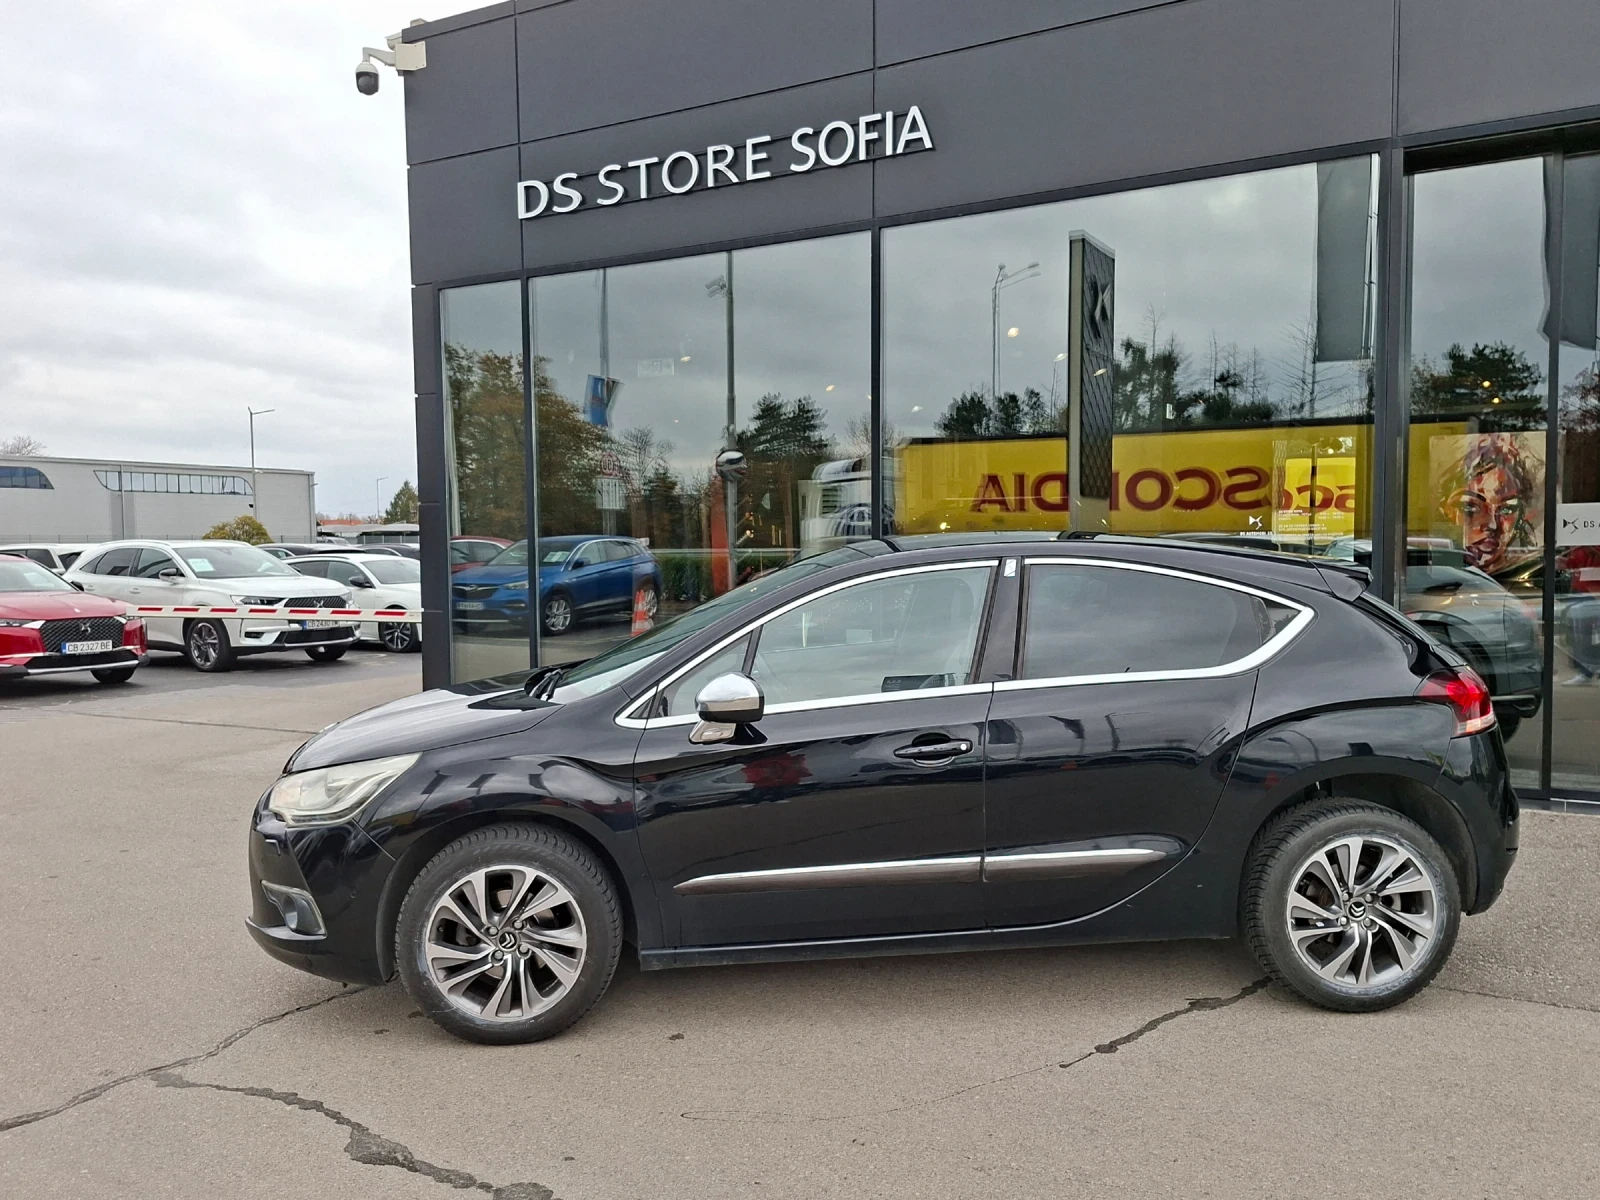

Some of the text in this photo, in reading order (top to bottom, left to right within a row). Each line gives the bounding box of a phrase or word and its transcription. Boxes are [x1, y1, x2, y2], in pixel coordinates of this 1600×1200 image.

[516, 105, 933, 220] DS STORE SOFIA
[68, 644, 78, 652] CB
[80, 643, 99, 651] 2327
